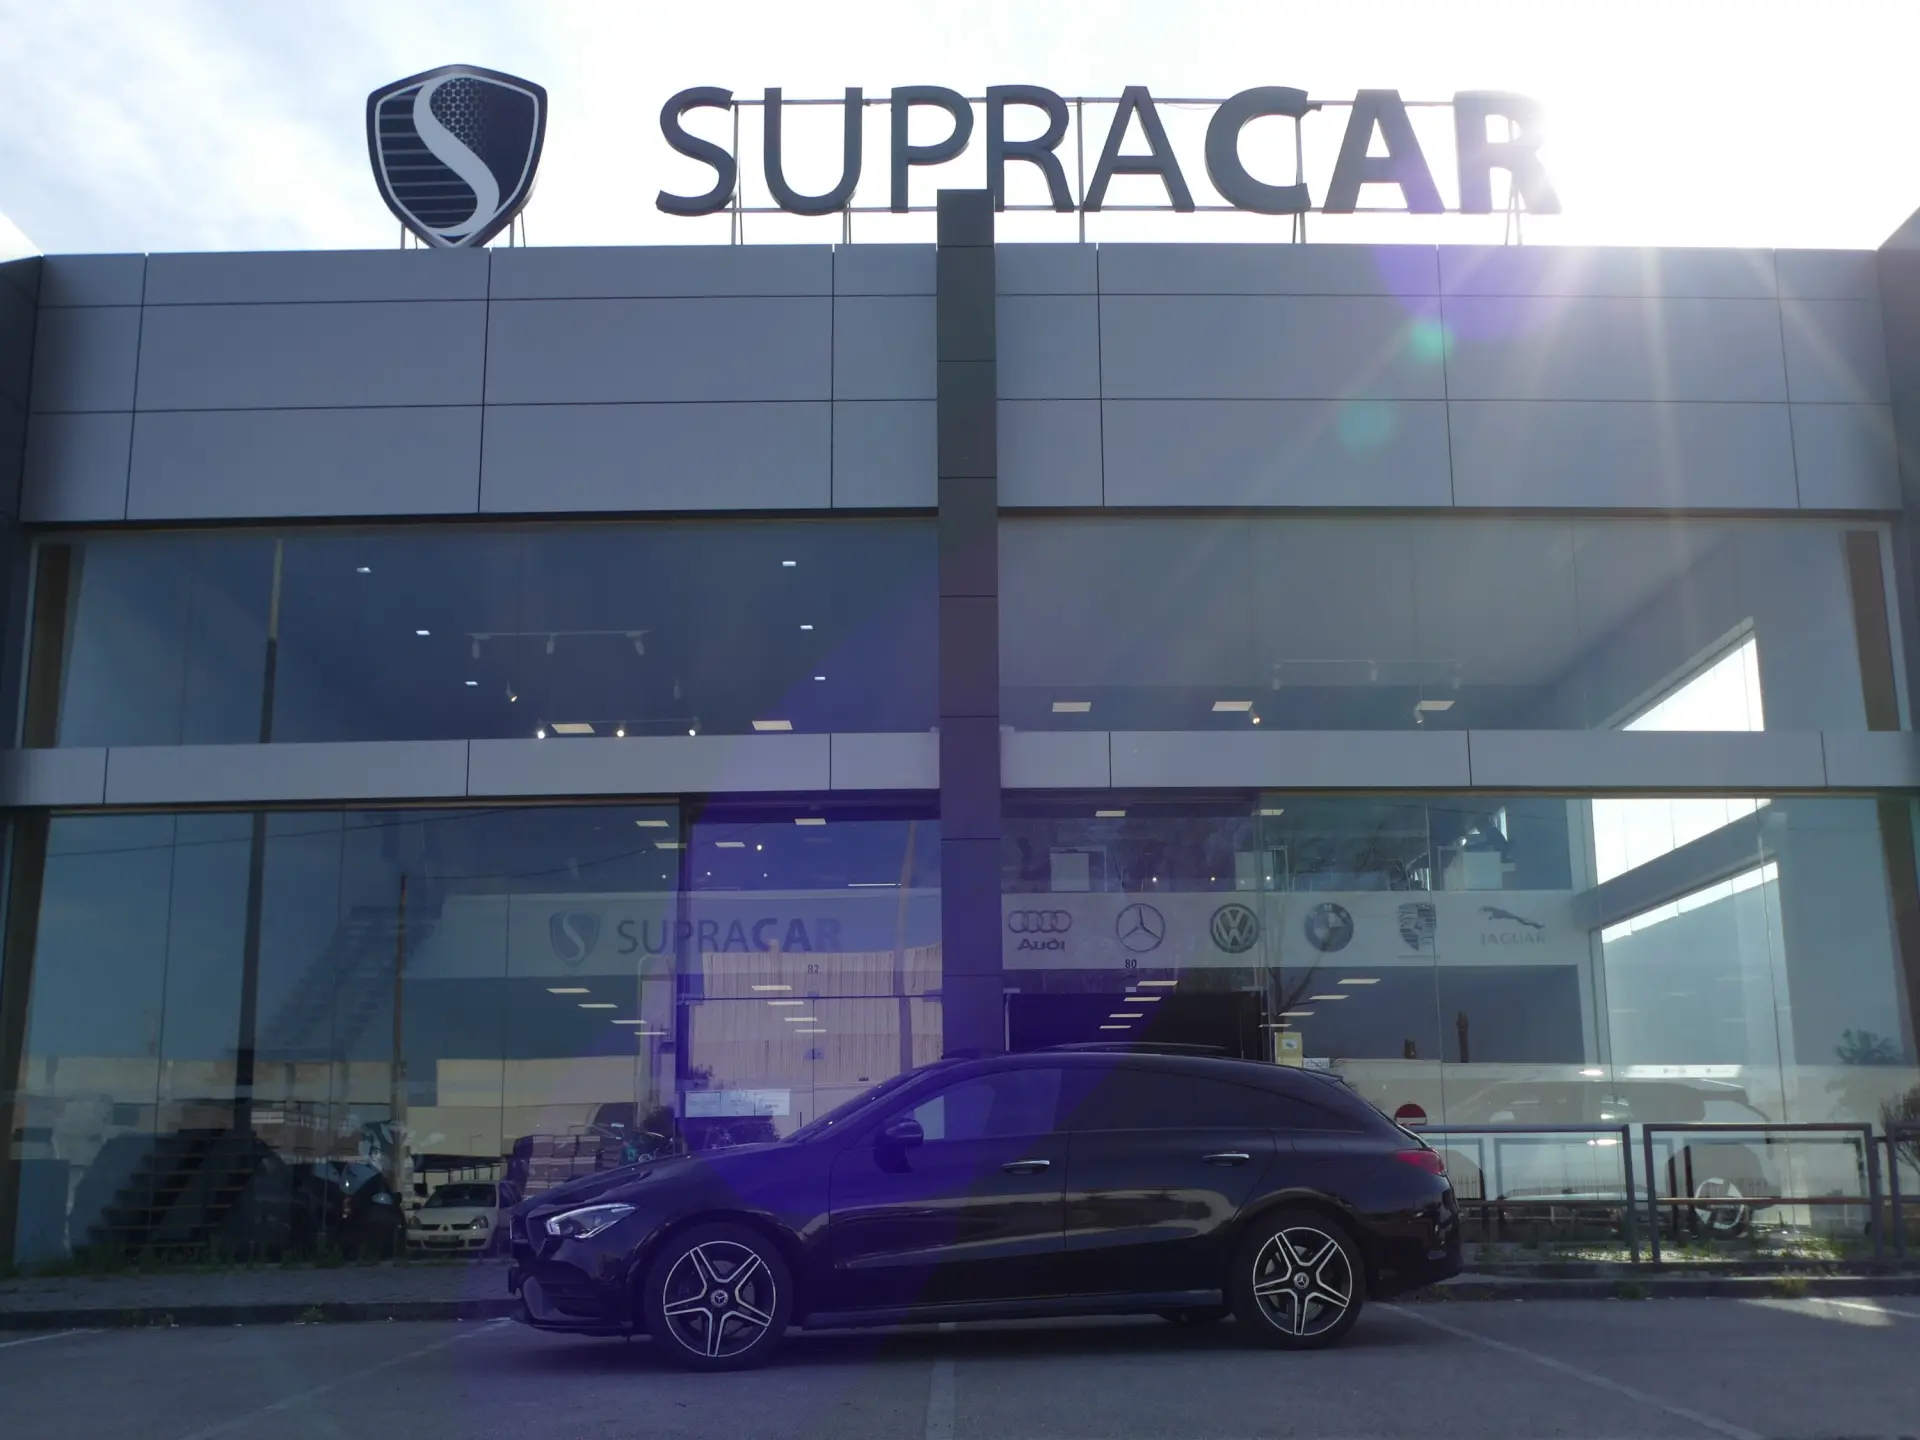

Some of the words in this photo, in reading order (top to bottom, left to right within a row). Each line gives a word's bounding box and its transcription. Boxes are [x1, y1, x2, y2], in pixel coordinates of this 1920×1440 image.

[656, 85, 1562, 216] SUPRACAR
[617, 917, 842, 955] SUPRACAR
[1479, 931, 1547, 947] JAGUAR
[1017, 938, 1066, 951] Audi
[808, 964, 819, 975] 82
[1125, 959, 1137, 969] 80
